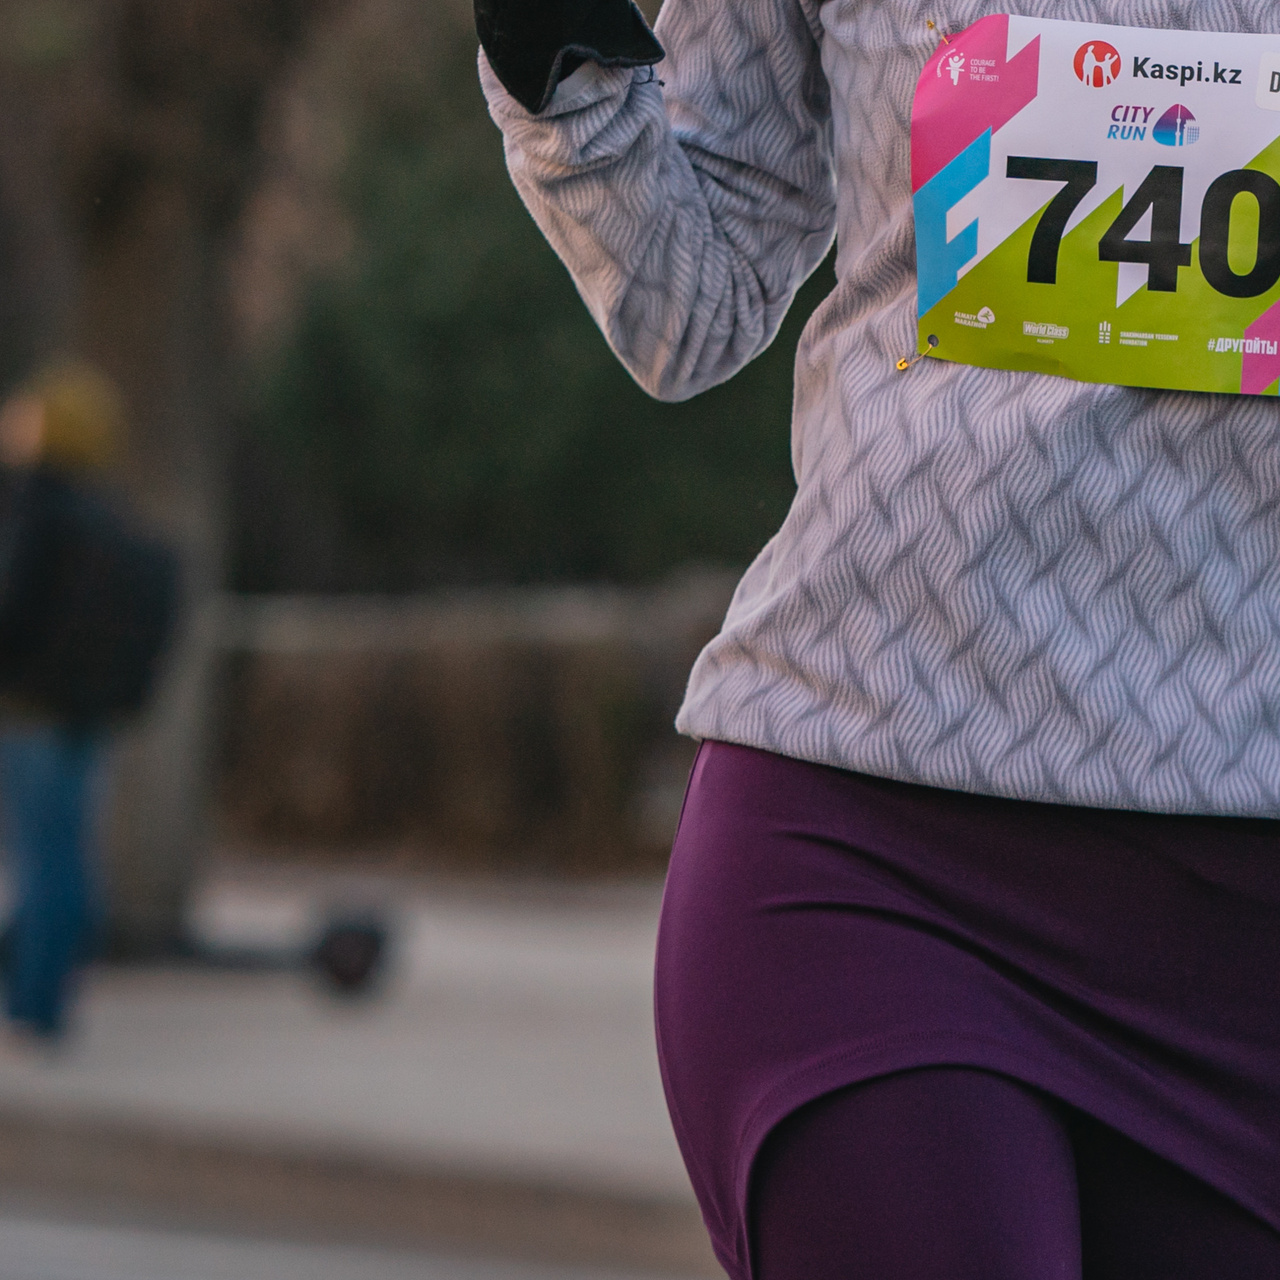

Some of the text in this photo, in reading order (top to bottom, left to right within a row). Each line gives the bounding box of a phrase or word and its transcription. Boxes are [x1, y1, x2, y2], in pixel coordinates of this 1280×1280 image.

[970, 59, 996, 67] COURAGE
[1133, 56, 1242, 87] Kaspi.kz
[1111, 104, 1155, 124] CITY
[1107, 124, 1147, 141] RUN
[954, 311, 977, 321] ALMATY
[954, 317, 987, 329] MARATHON
[1024, 322, 1068, 337] World Class
[1207, 336, 1278, 355] #ДРУГОЙТЫ
